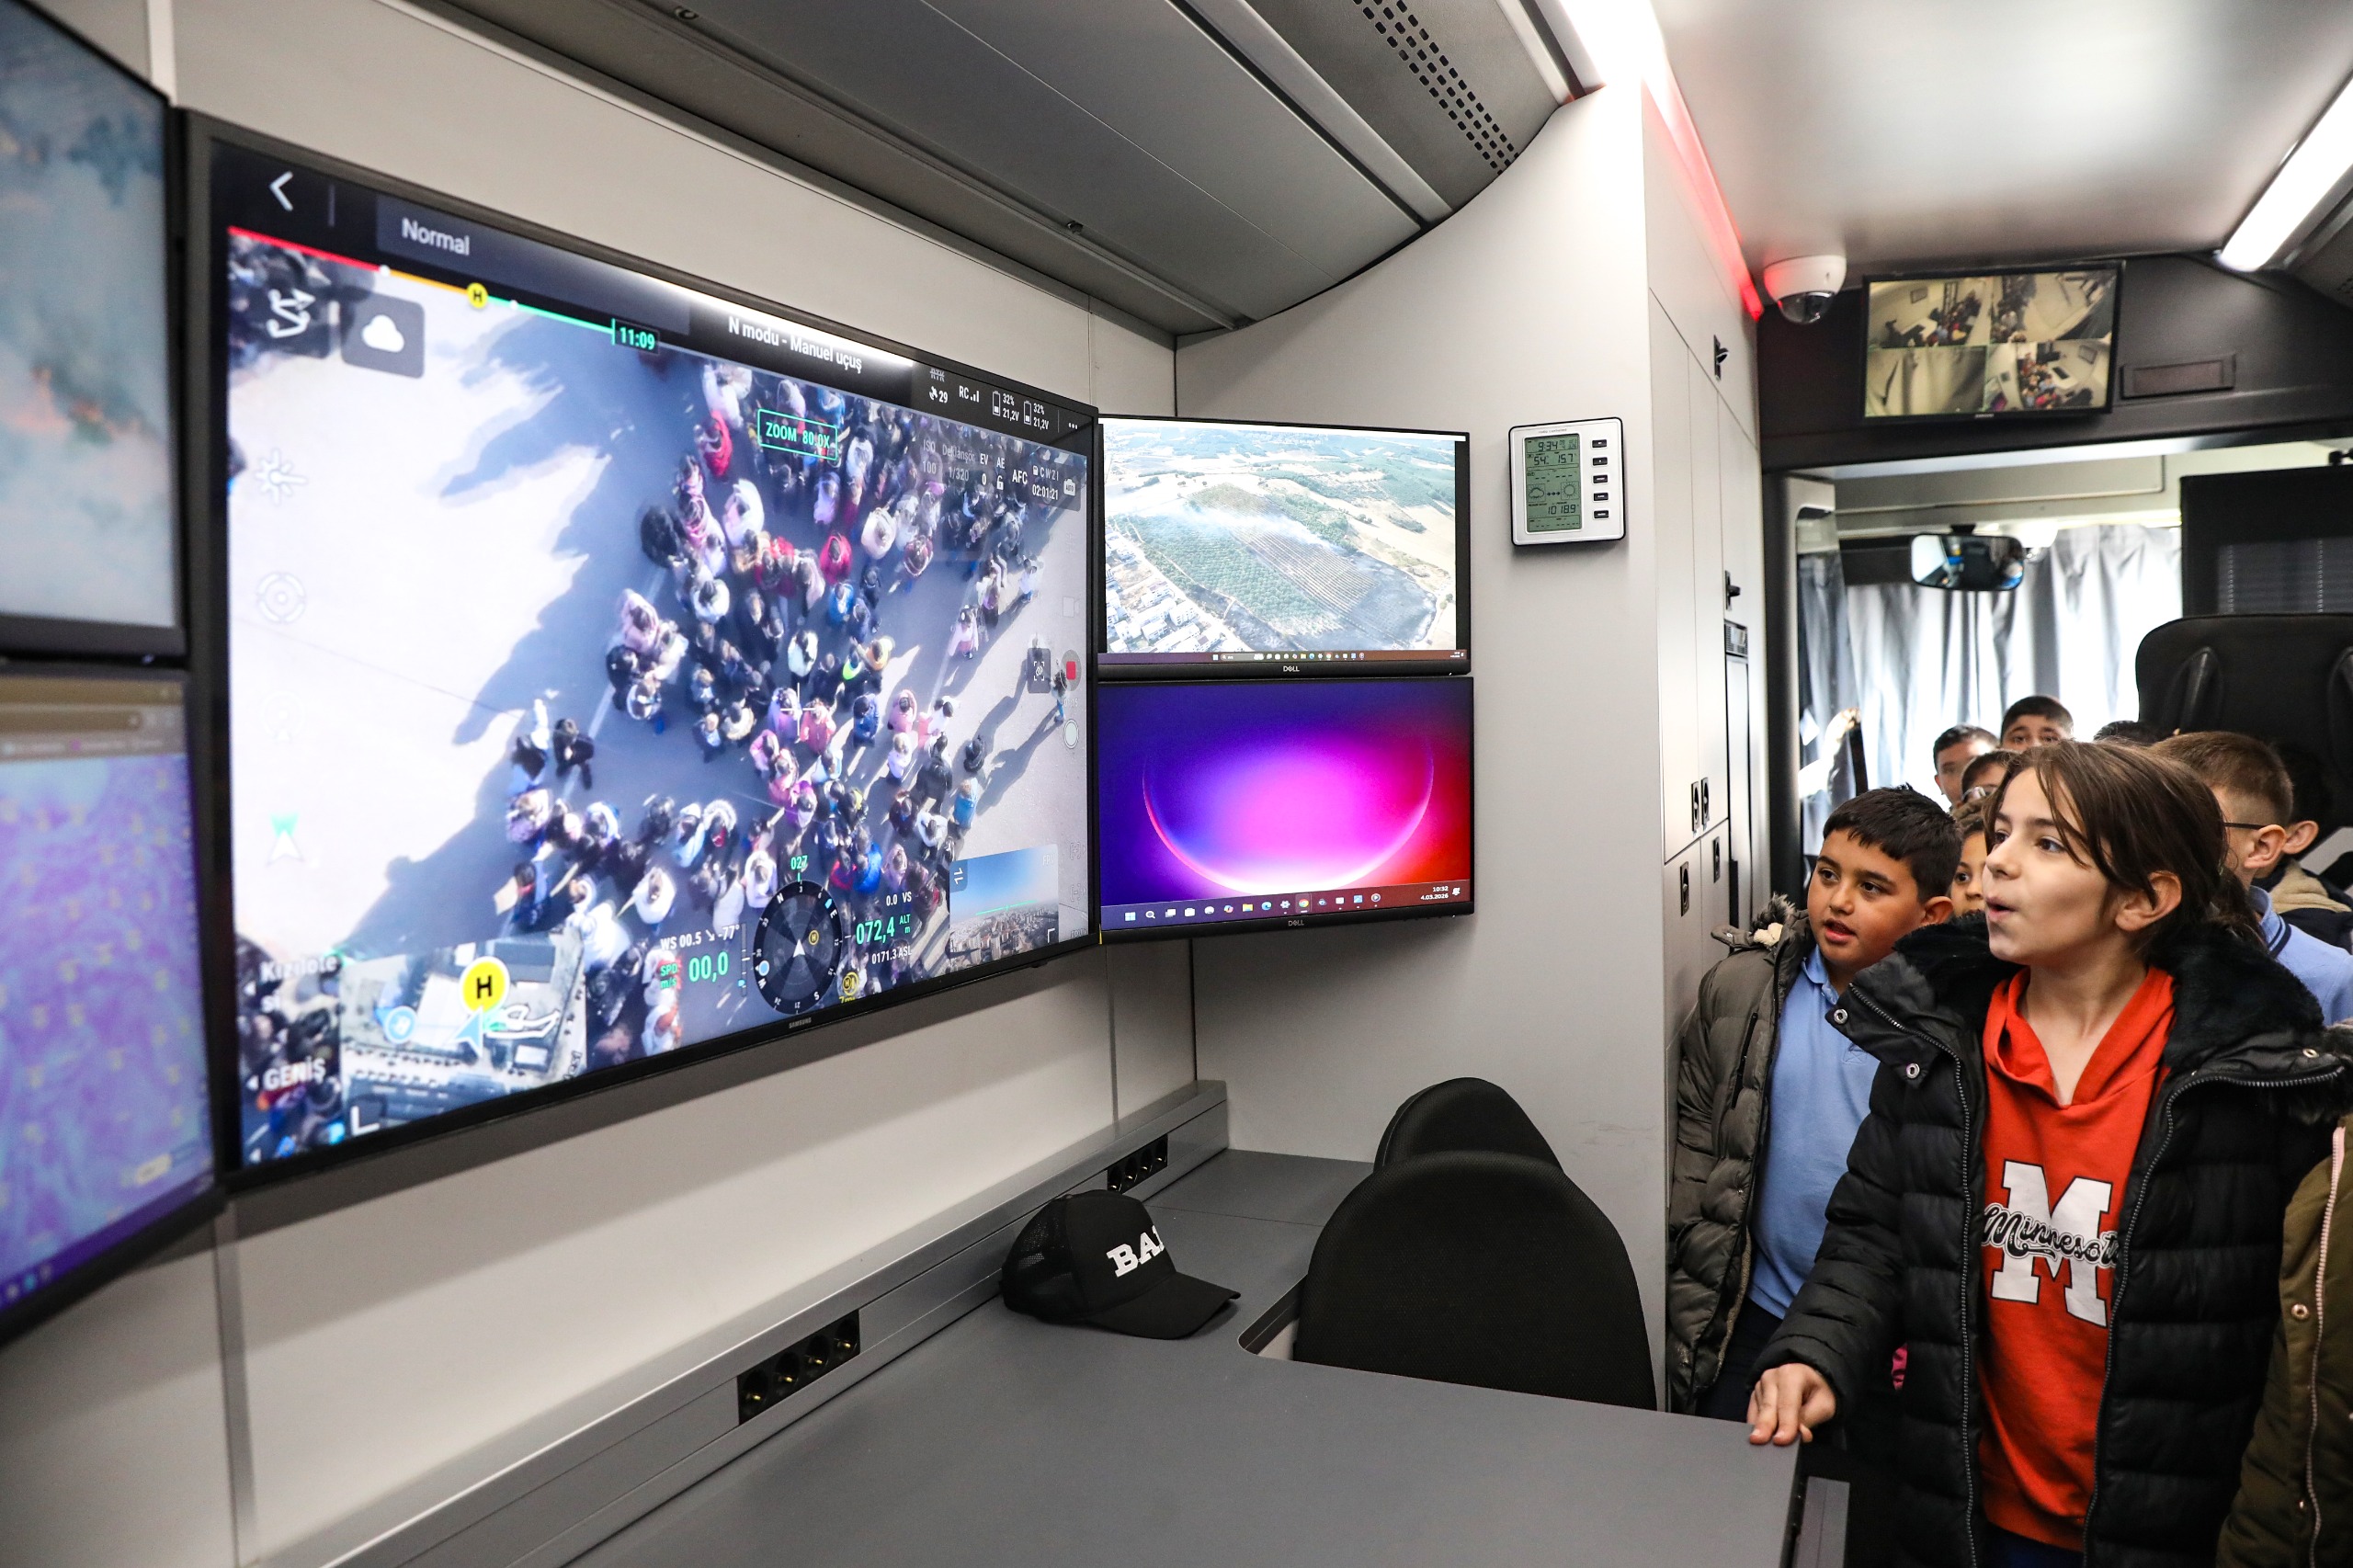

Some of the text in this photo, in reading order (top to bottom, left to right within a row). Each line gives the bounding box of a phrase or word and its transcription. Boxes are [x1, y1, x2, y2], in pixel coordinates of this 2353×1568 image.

[401, 217, 472, 256] Normal
[472, 290, 483, 303] H
[620, 325, 655, 351] 11:09
[728, 315, 740, 335] N
[742, 323, 779, 347] modu
[790, 335, 834, 362] Manuel
[835, 351, 862, 374] uçuş
[938, 390, 949, 403] 29
[959, 385, 970, 399] RC
[1002, 392, 1015, 406] 32%
[1002, 407, 1019, 423] 21,2V
[1033, 403, 1045, 415] 32%
[1033, 416, 1050, 430] 21,2V
[766, 421, 830, 449] ZOOM 80.0X
[923, 441, 936, 453] ISO
[1538, 440, 1558, 452] 9:34
[980, 453, 989, 465] EV
[996, 458, 1006, 470] AE
[1534, 456, 1546, 466] 54
[922, 460, 937, 474] 100
[948, 467, 970, 483] 1/320
[982, 473, 987, 485] 0
[1012, 470, 1028, 485] AFC
[1032, 483, 1059, 501] 02:01:21
[790, 855, 808, 870] 027
[777, 892, 784, 903] N
[885, 891, 912, 906] 0.0 VS
[899, 914, 911, 925] ALT
[856, 915, 895, 945] 072,4
[904, 926, 911, 934] m
[660, 924, 740, 951] WS 00.5 -77°
[871, 946, 912, 964] 0171.3 ASL
[660, 962, 678, 977] SPD
[688, 950, 729, 983] 00,0
[475, 975, 493, 999] H
[660, 977, 677, 990] m/s
[789, 1017, 812, 1029] SAMSUNG
[262, 1056, 326, 1091] GENİŞ
[1992, 1159, 2112, 1329] M
